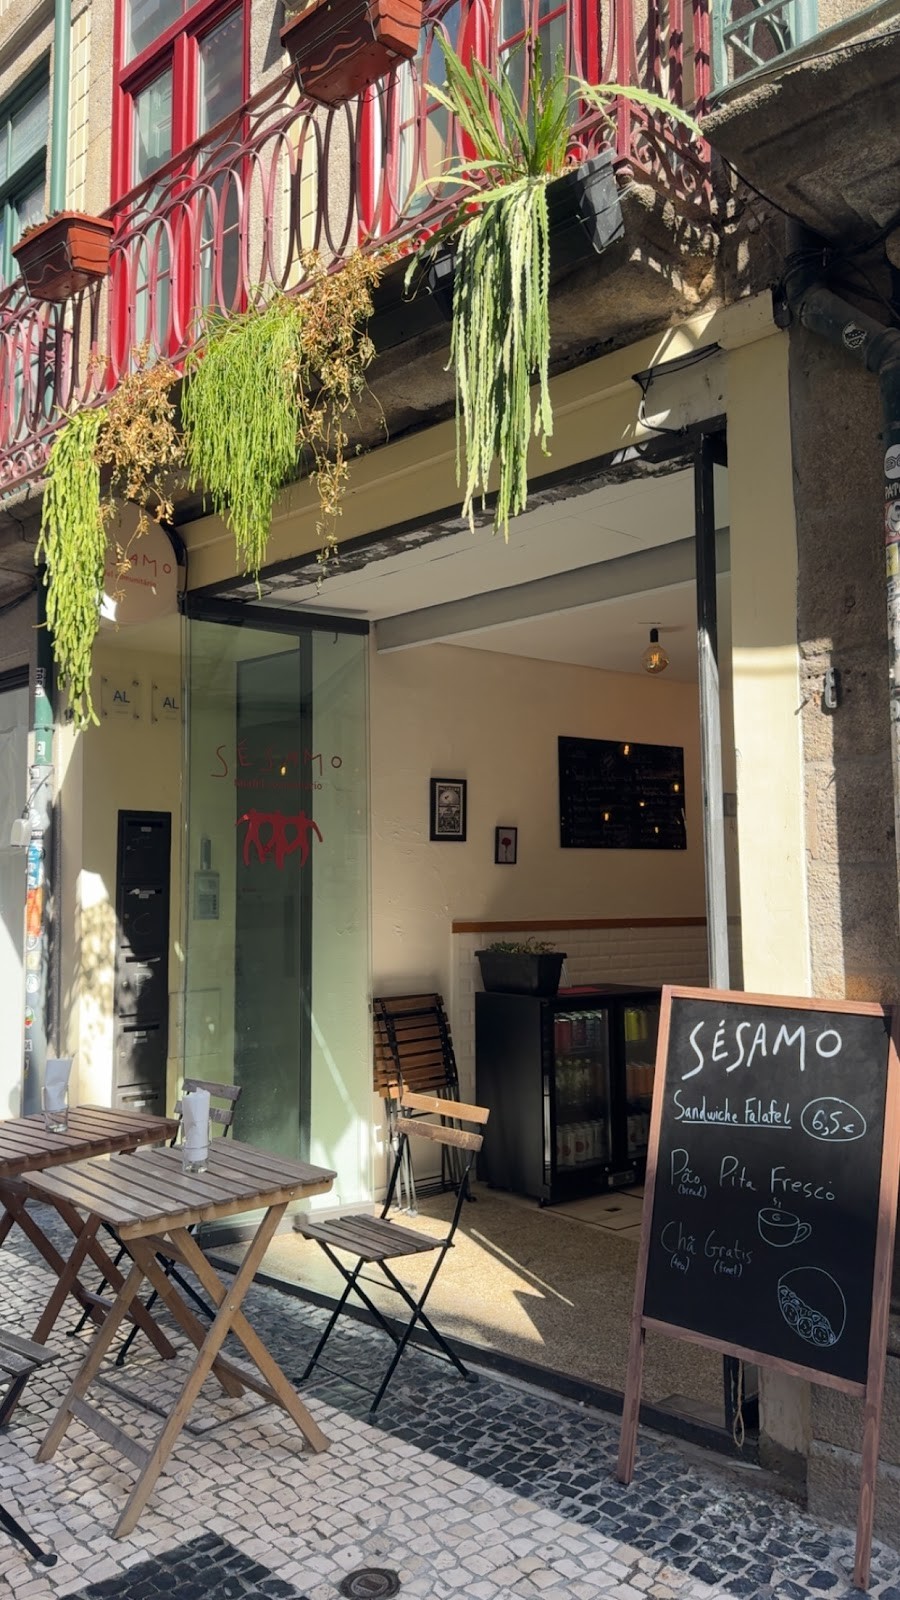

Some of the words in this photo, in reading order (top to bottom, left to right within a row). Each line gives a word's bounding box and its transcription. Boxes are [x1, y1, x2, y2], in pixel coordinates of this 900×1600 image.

[113, 690, 130, 703] AL
[162, 696, 179, 709] AL
[681, 1019, 842, 1080] SÉSAMO
[673, 1089, 738, 1123] Sandwiche
[745, 1097, 791, 1125] Falafel
[671, 1148, 700, 1185] Pão
[719, 1155, 756, 1191] Pita
[770, 1166, 835, 1201] Fresco
[670, 1253, 690, 1274] (tea)
[704, 1229, 753, 1264] Gratis
